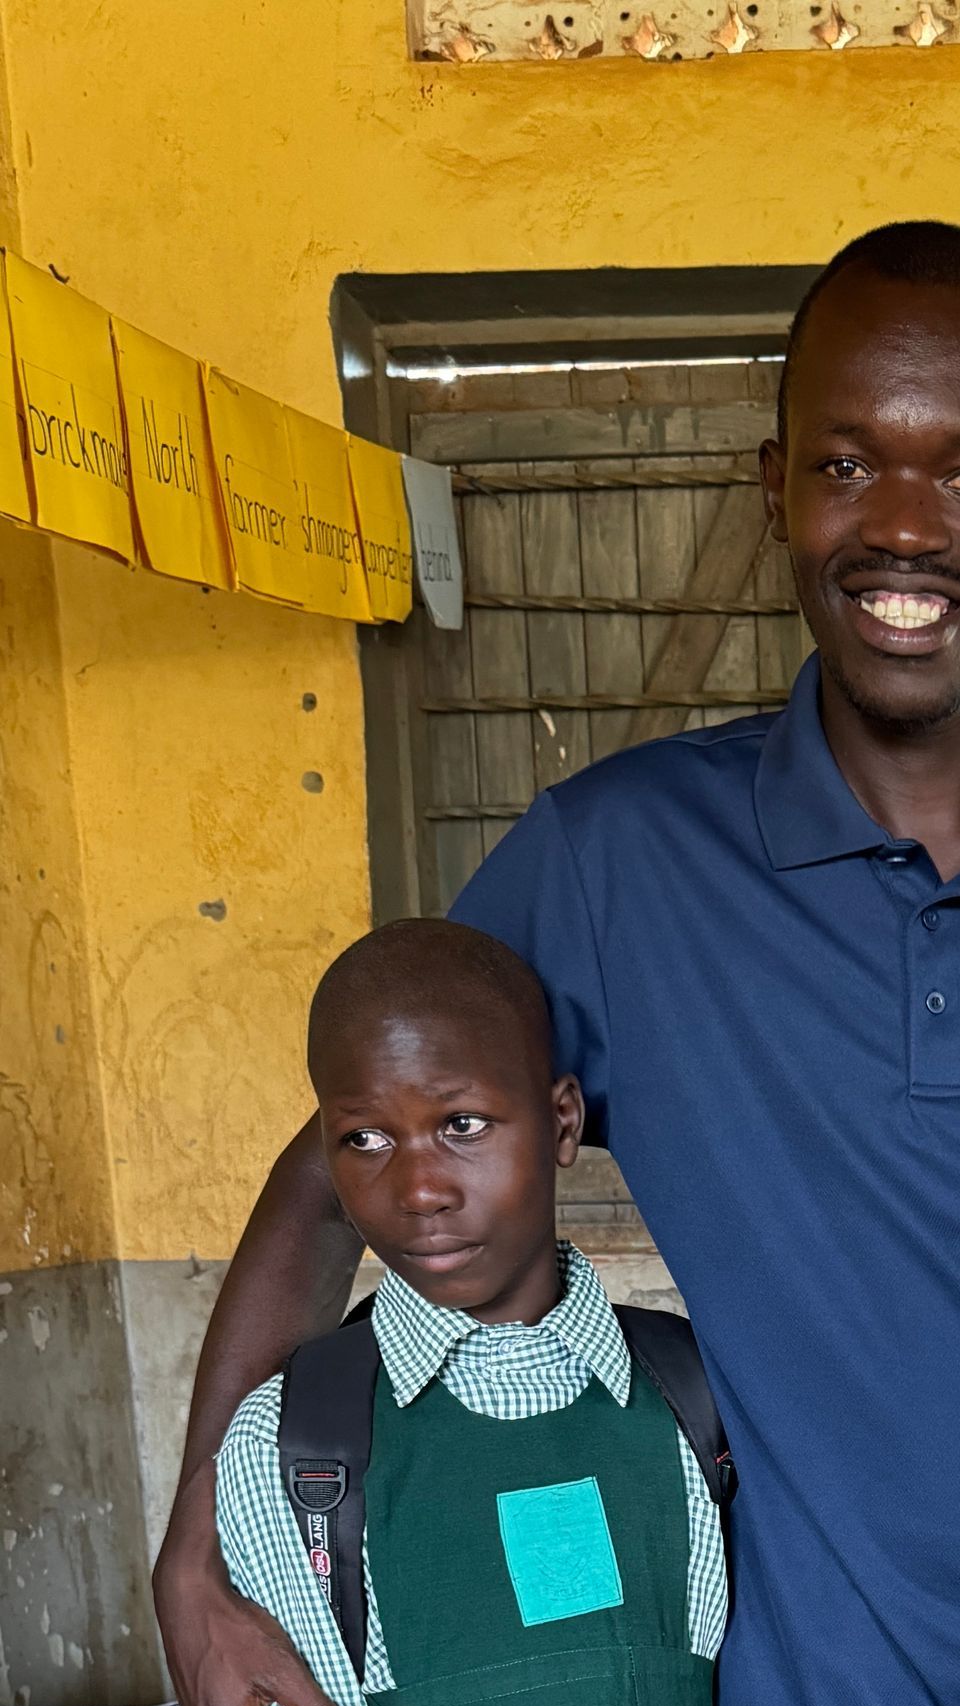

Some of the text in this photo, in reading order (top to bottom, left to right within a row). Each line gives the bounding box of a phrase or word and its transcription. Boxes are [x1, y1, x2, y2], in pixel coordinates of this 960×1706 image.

[140, 396, 201, 498] North
[224, 453, 289, 550] farmer
[312, 1513, 325, 1549] LANG
[315, 1551, 326, 1574] OSL
